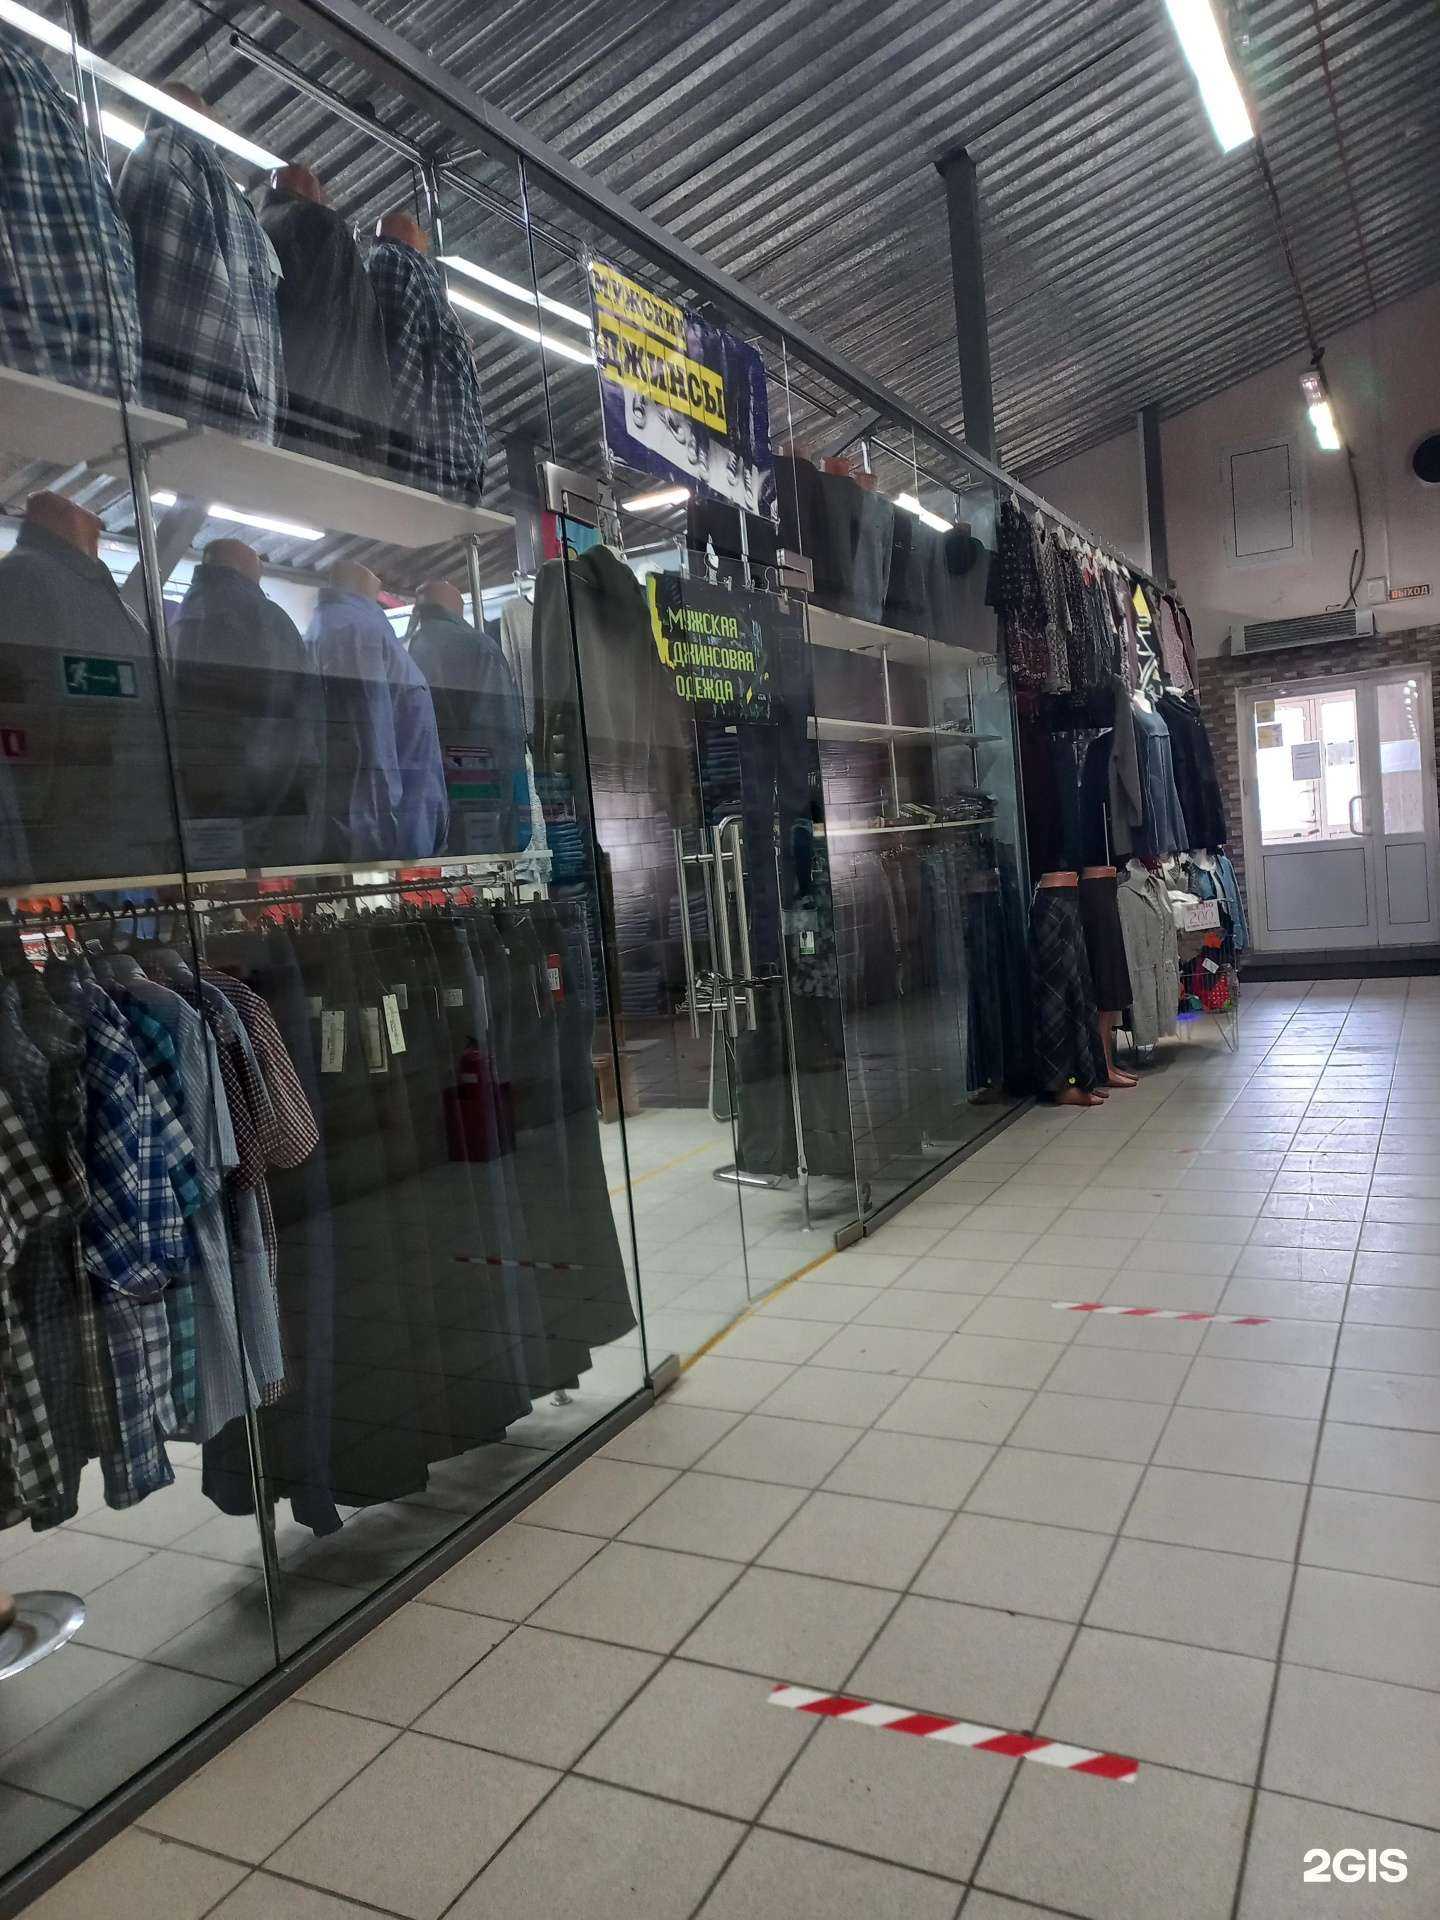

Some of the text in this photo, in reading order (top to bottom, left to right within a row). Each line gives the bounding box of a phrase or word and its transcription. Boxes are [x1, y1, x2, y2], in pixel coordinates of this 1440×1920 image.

[598, 326, 725, 420] ДЖИНСЫ
[1391, 585, 1428, 599] ВЫХОД
[667, 606, 738, 638] МУЖСКАЯ
[673, 641, 755, 671] ДЖИНСОВАЯ
[676, 675, 733, 703] ОДЕЖДА
